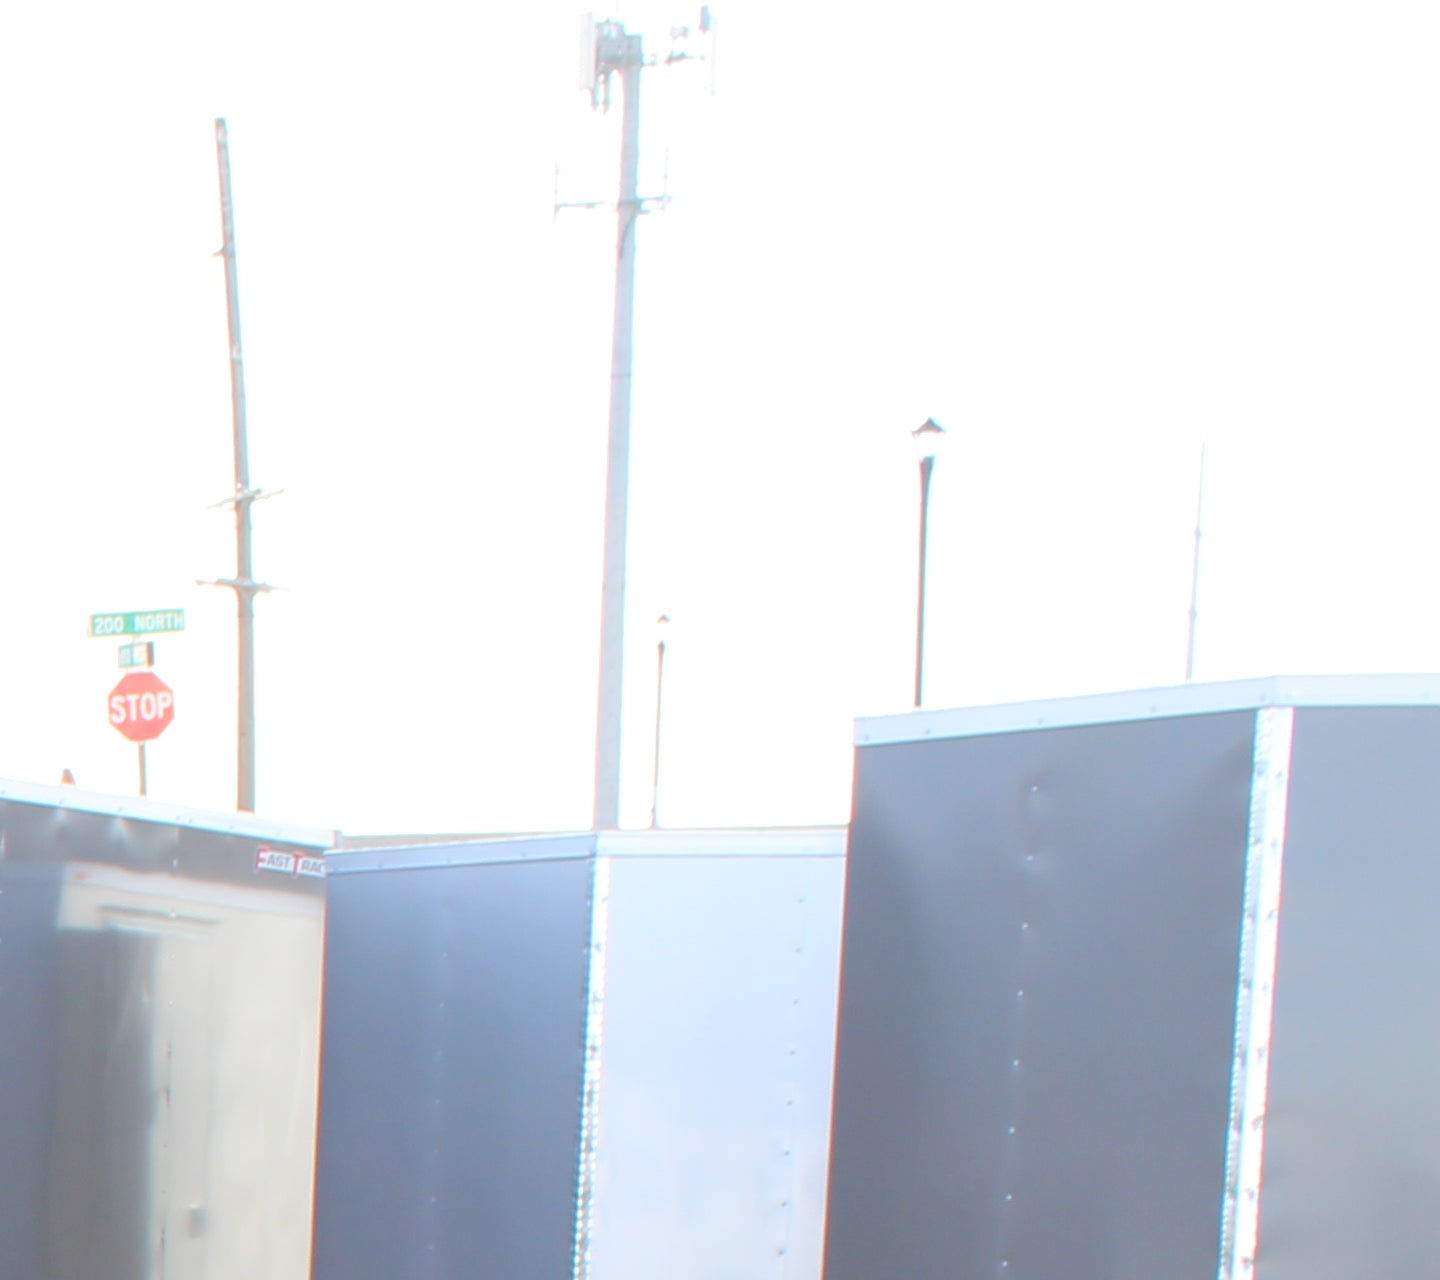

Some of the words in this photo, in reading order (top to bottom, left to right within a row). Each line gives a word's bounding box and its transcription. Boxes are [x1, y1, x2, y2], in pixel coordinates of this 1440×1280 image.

[94, 615, 125, 635] 200
[134, 611, 184, 632] NORTH
[111, 691, 172, 724] STOP
